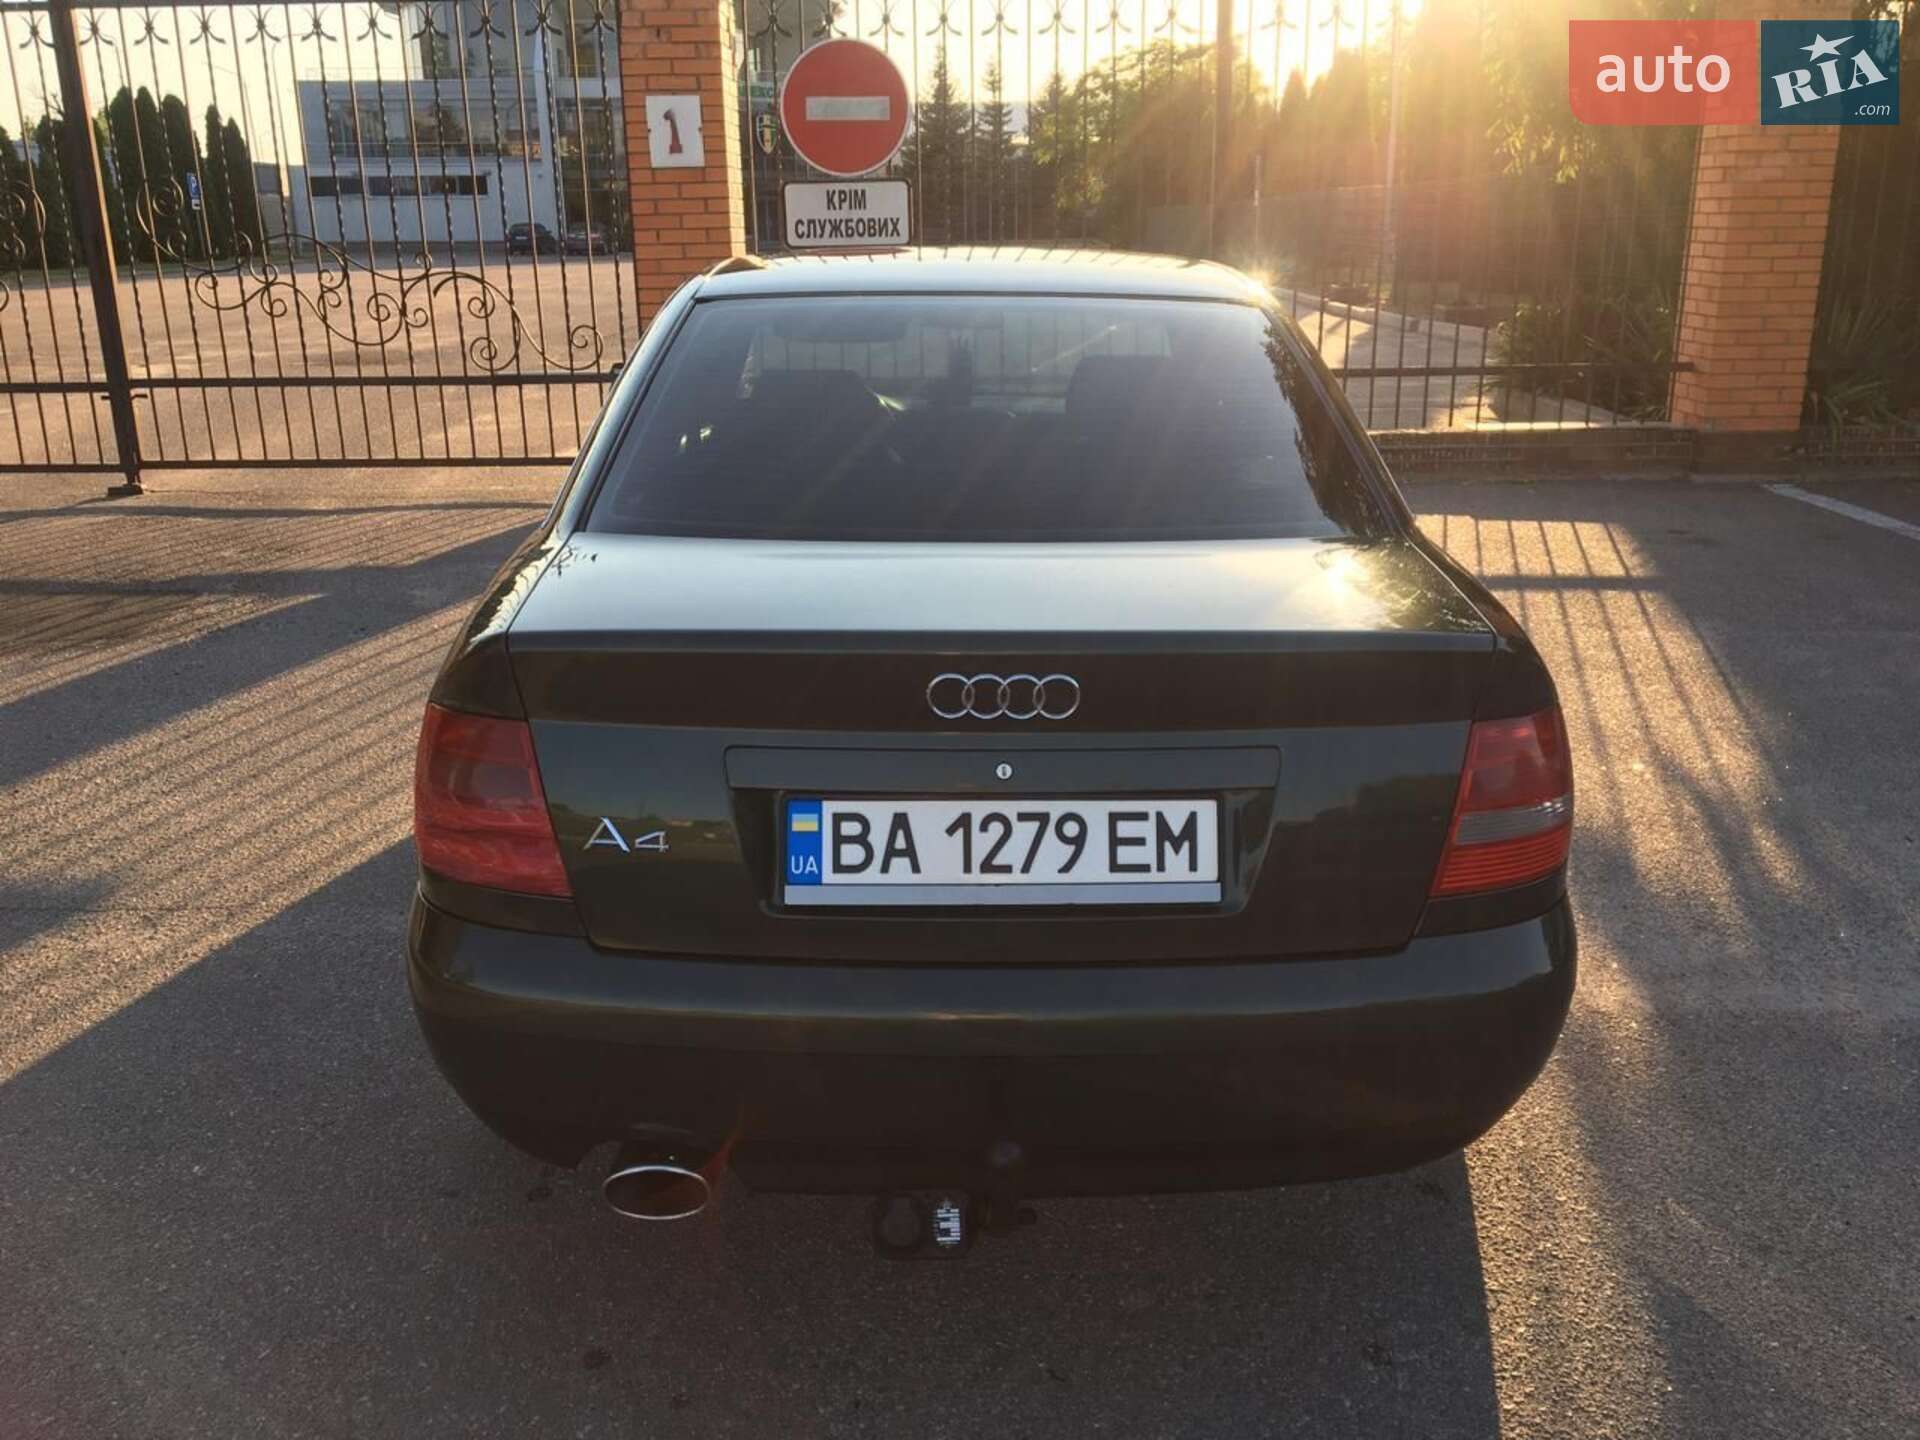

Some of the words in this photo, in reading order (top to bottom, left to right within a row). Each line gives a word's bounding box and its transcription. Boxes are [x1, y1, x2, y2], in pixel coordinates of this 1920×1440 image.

[663, 109, 683, 154] 1
[826, 189, 866, 210] КРІМ
[794, 217, 900, 239] СЛУЖБОВИХ
[583, 816, 670, 853] A4
[831, 812, 922, 874] BA
[945, 812, 1088, 874] 1279
[1108, 811, 1198, 872] EM
[791, 855, 819, 874] UA
